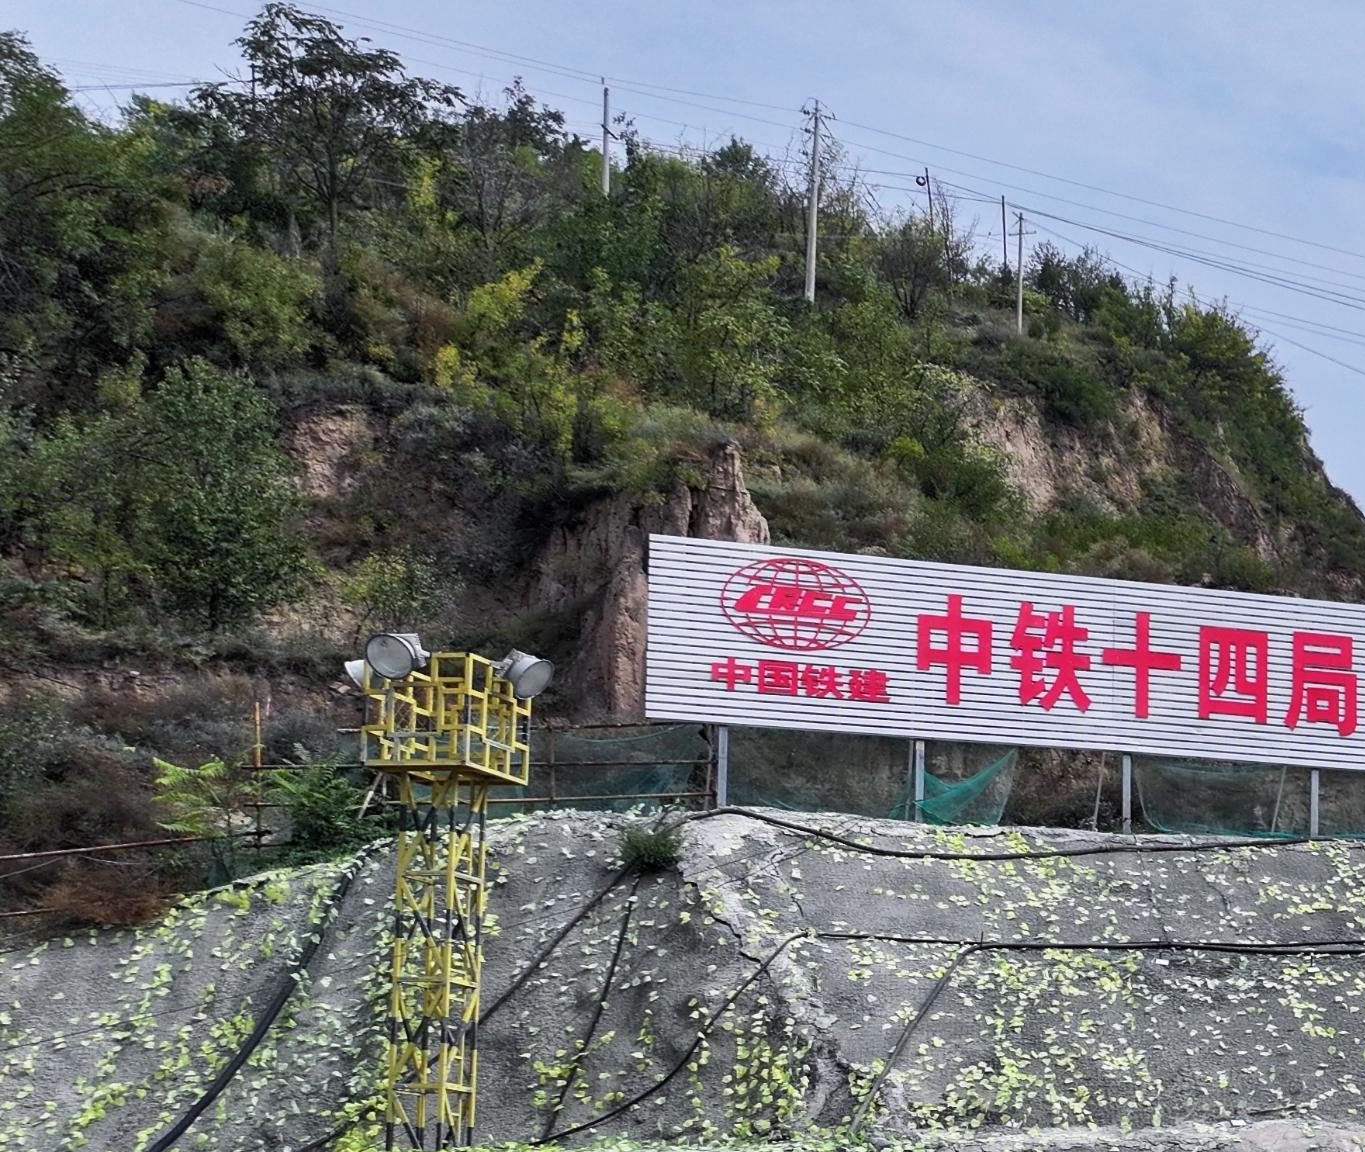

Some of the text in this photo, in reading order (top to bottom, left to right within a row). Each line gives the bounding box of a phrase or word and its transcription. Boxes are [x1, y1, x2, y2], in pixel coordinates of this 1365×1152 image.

[734, 585, 864, 621] CRCC
[711, 656, 892, 703] 中国铁建
